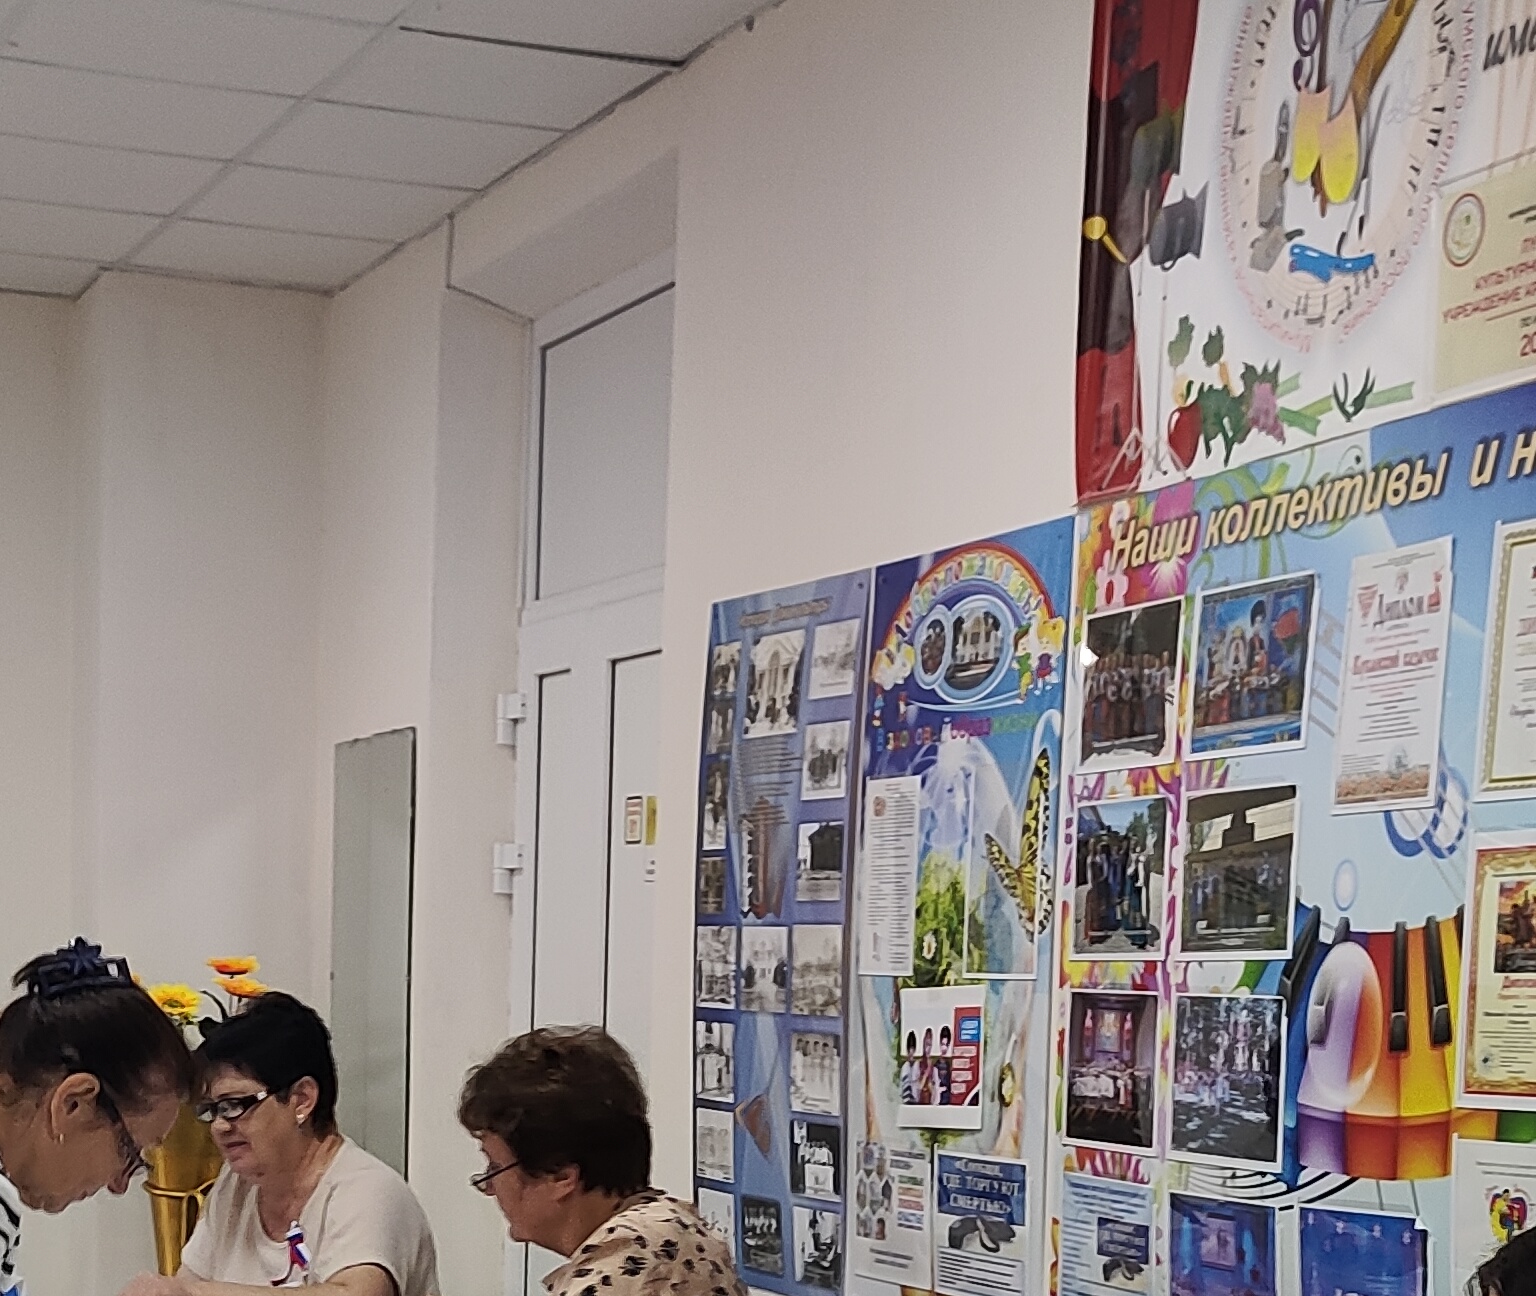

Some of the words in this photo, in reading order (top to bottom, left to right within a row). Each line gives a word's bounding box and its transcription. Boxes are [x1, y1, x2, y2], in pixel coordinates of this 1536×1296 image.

[1108, 512, 1201, 573] Наши
[1203, 453, 1449, 549] коллективы
[1469, 438, 1495, 488] и
